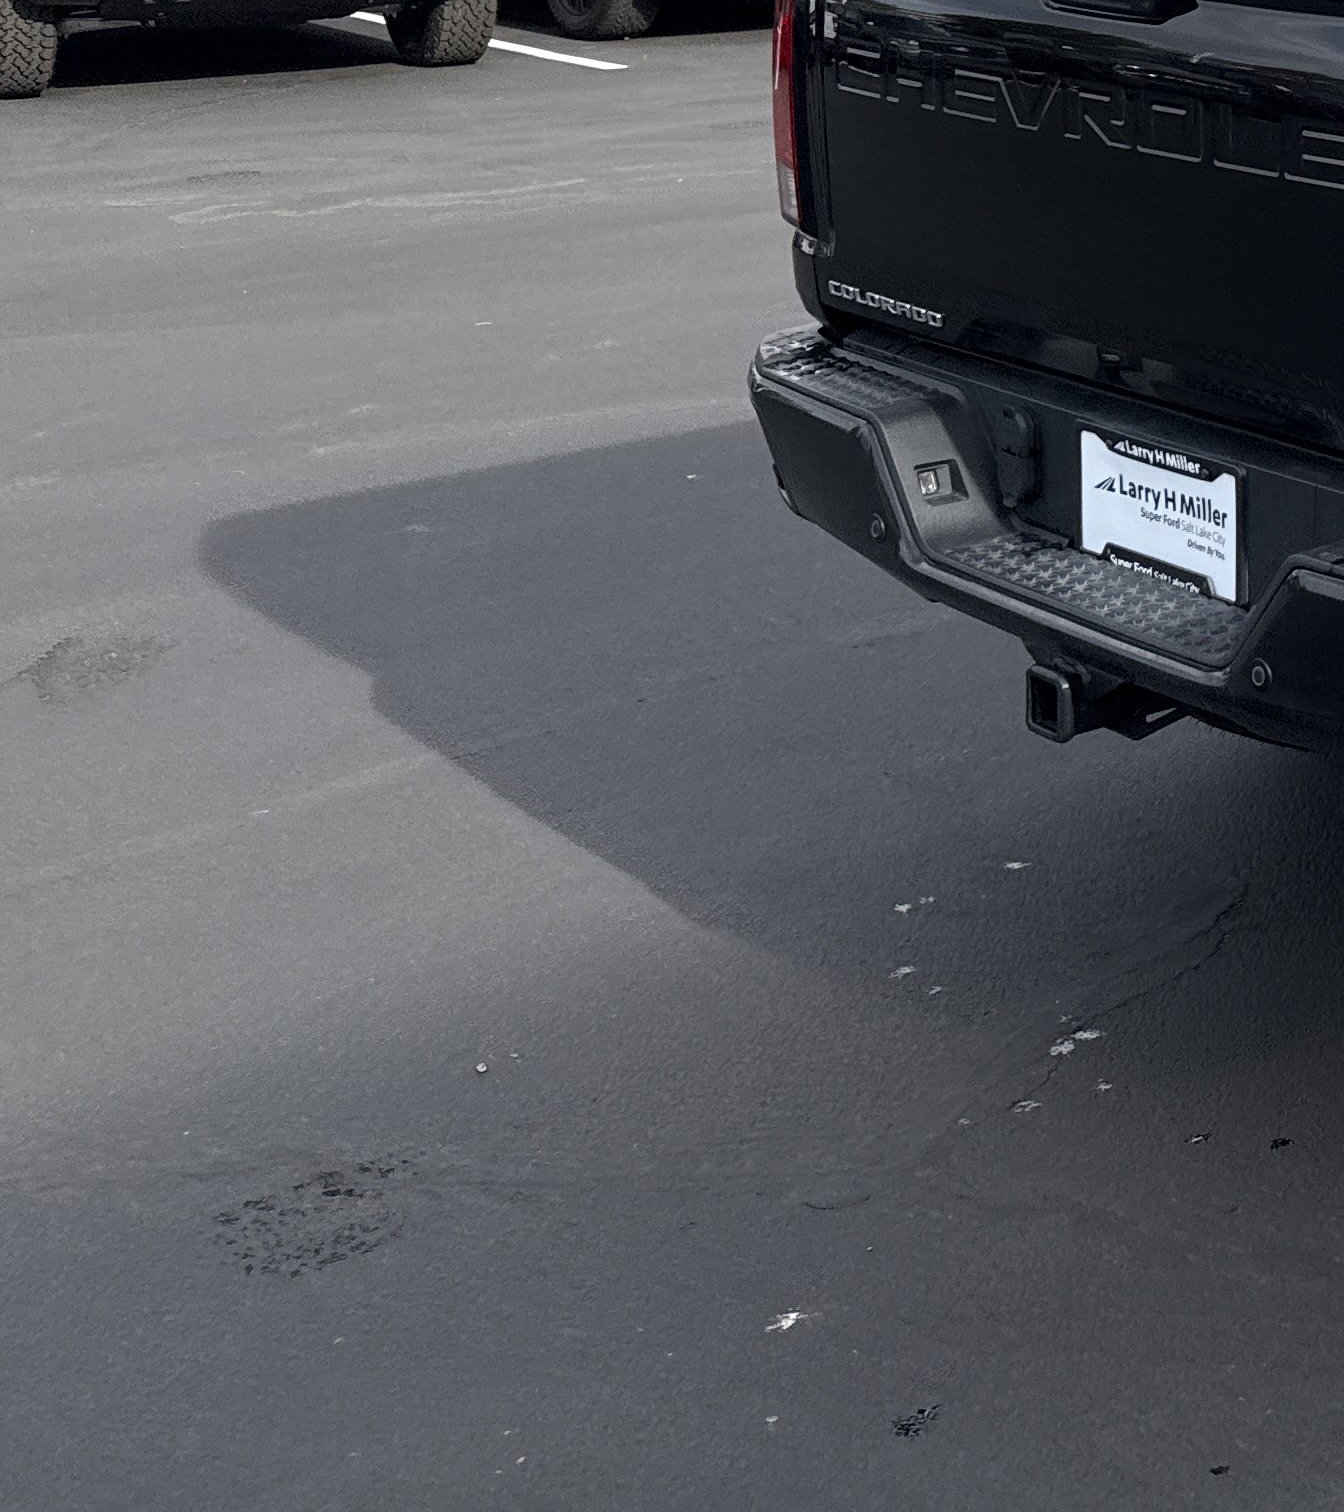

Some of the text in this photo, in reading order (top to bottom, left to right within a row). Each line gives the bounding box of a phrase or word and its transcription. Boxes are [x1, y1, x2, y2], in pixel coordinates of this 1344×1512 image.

[828, 280, 943, 327] COLORADO
[1125, 440, 1201, 474] Larry H Miller
[1119, 473, 1228, 528] Larry H Miller
[1140, 507, 1226, 547] Super Ford Salt Lake City
